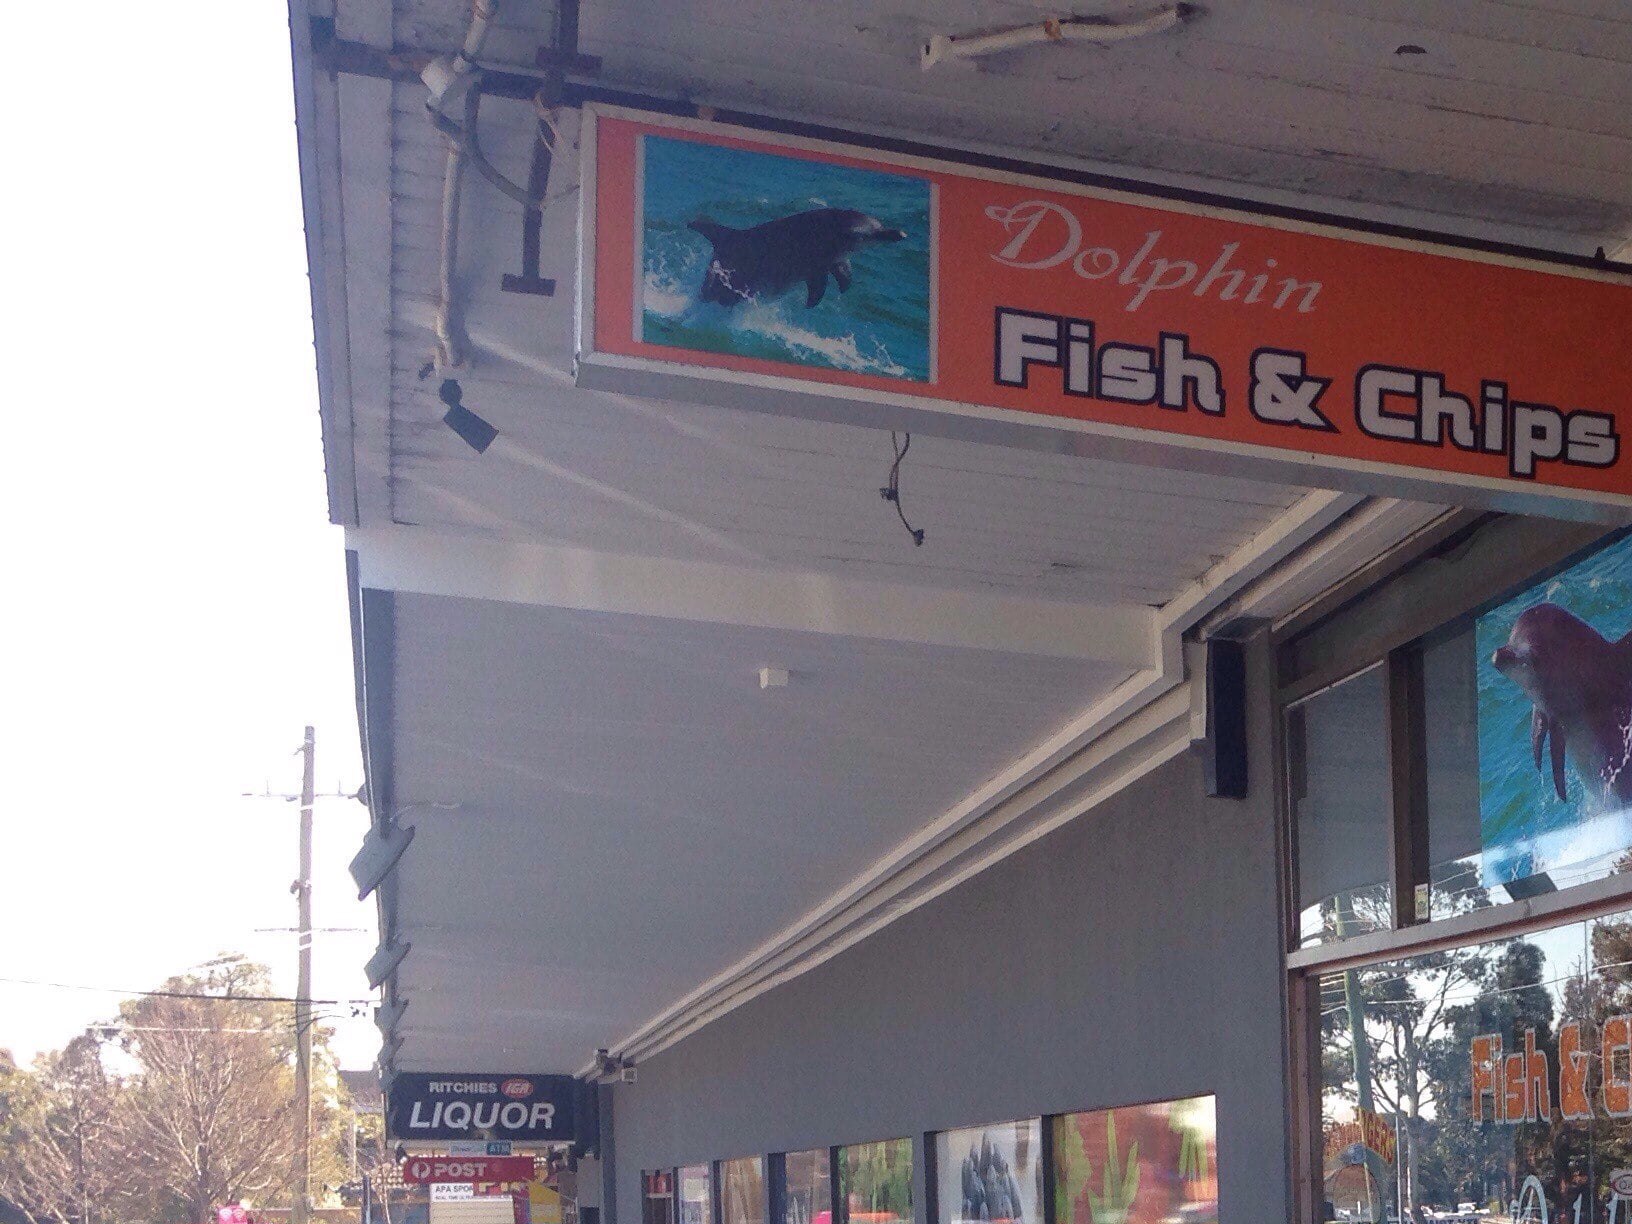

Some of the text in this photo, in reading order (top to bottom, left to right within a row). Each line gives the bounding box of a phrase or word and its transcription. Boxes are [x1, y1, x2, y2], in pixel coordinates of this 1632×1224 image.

[984, 200, 1323, 312] Dolphin
[994, 306, 1621, 480] Fish & Chips
[429, 1081, 498, 1094] RITCHIES
[1471, 1027, 1551, 1126] Fish
[1559, 1021, 1596, 1120] &
[409, 1100, 556, 1131] LIQUOR
[433, 1162, 488, 1178] POST
